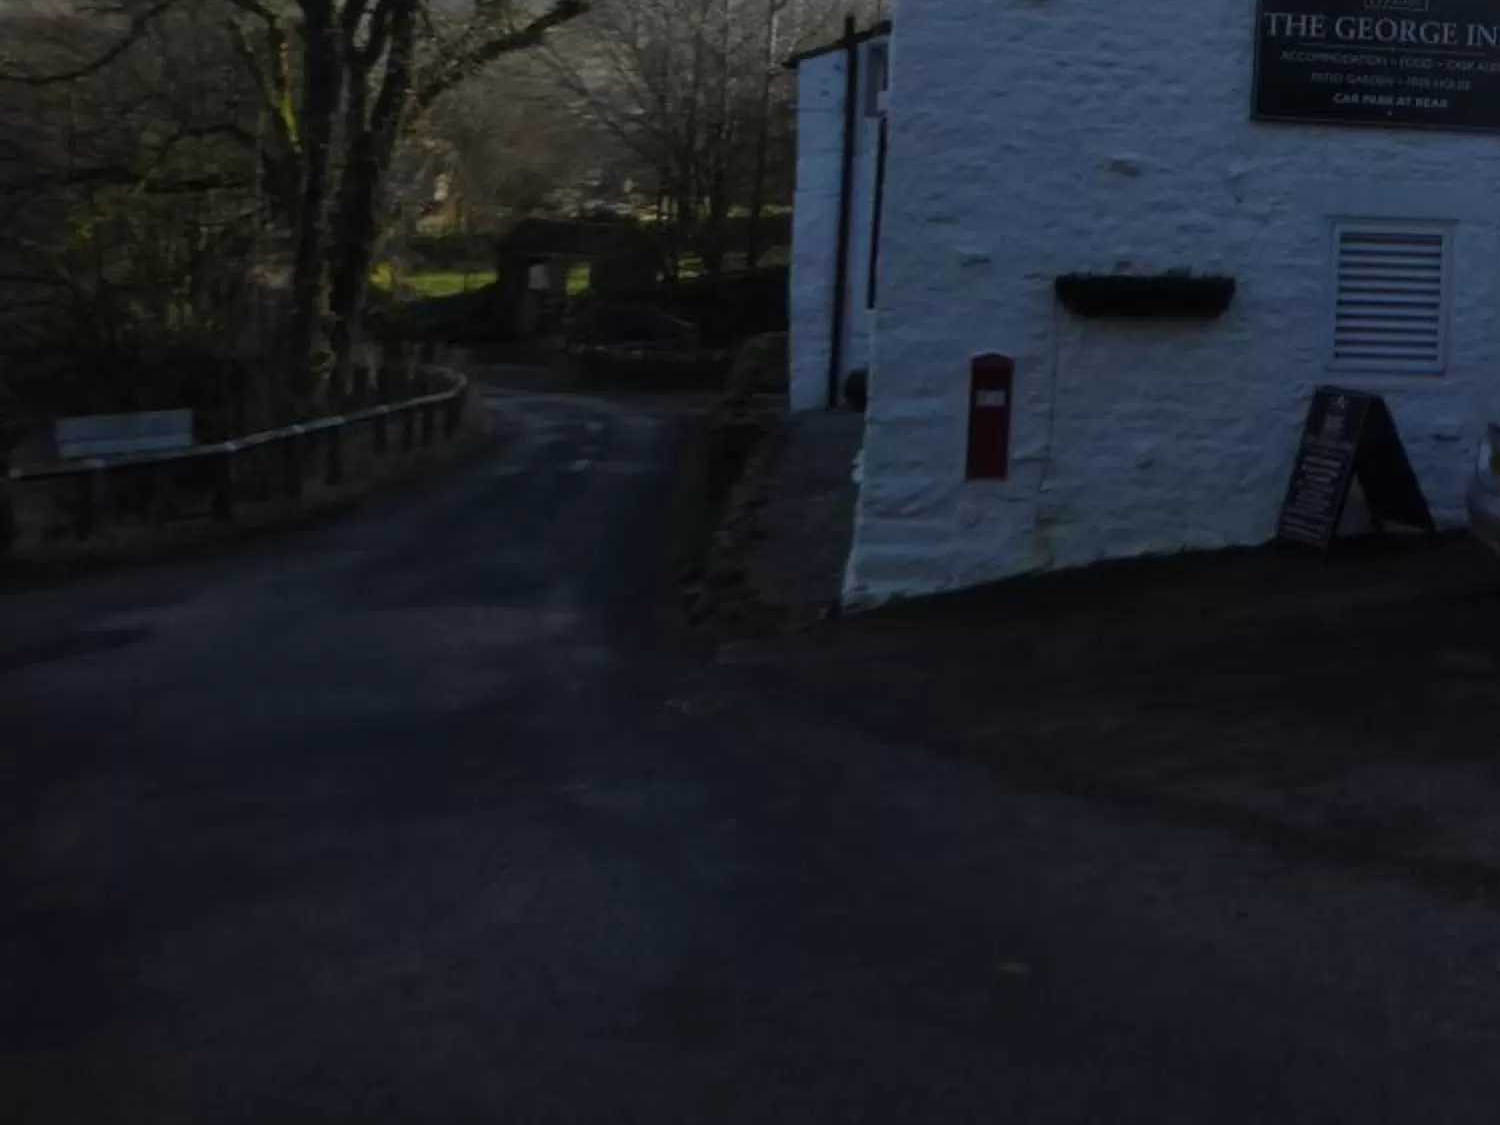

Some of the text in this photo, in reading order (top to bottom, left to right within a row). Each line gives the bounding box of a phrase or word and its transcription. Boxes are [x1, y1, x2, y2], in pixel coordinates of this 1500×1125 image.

[1263, 11, 1326, 39] THE
[1335, 15, 1458, 45] GEORGE
[1332, 92, 1359, 105] CAR
